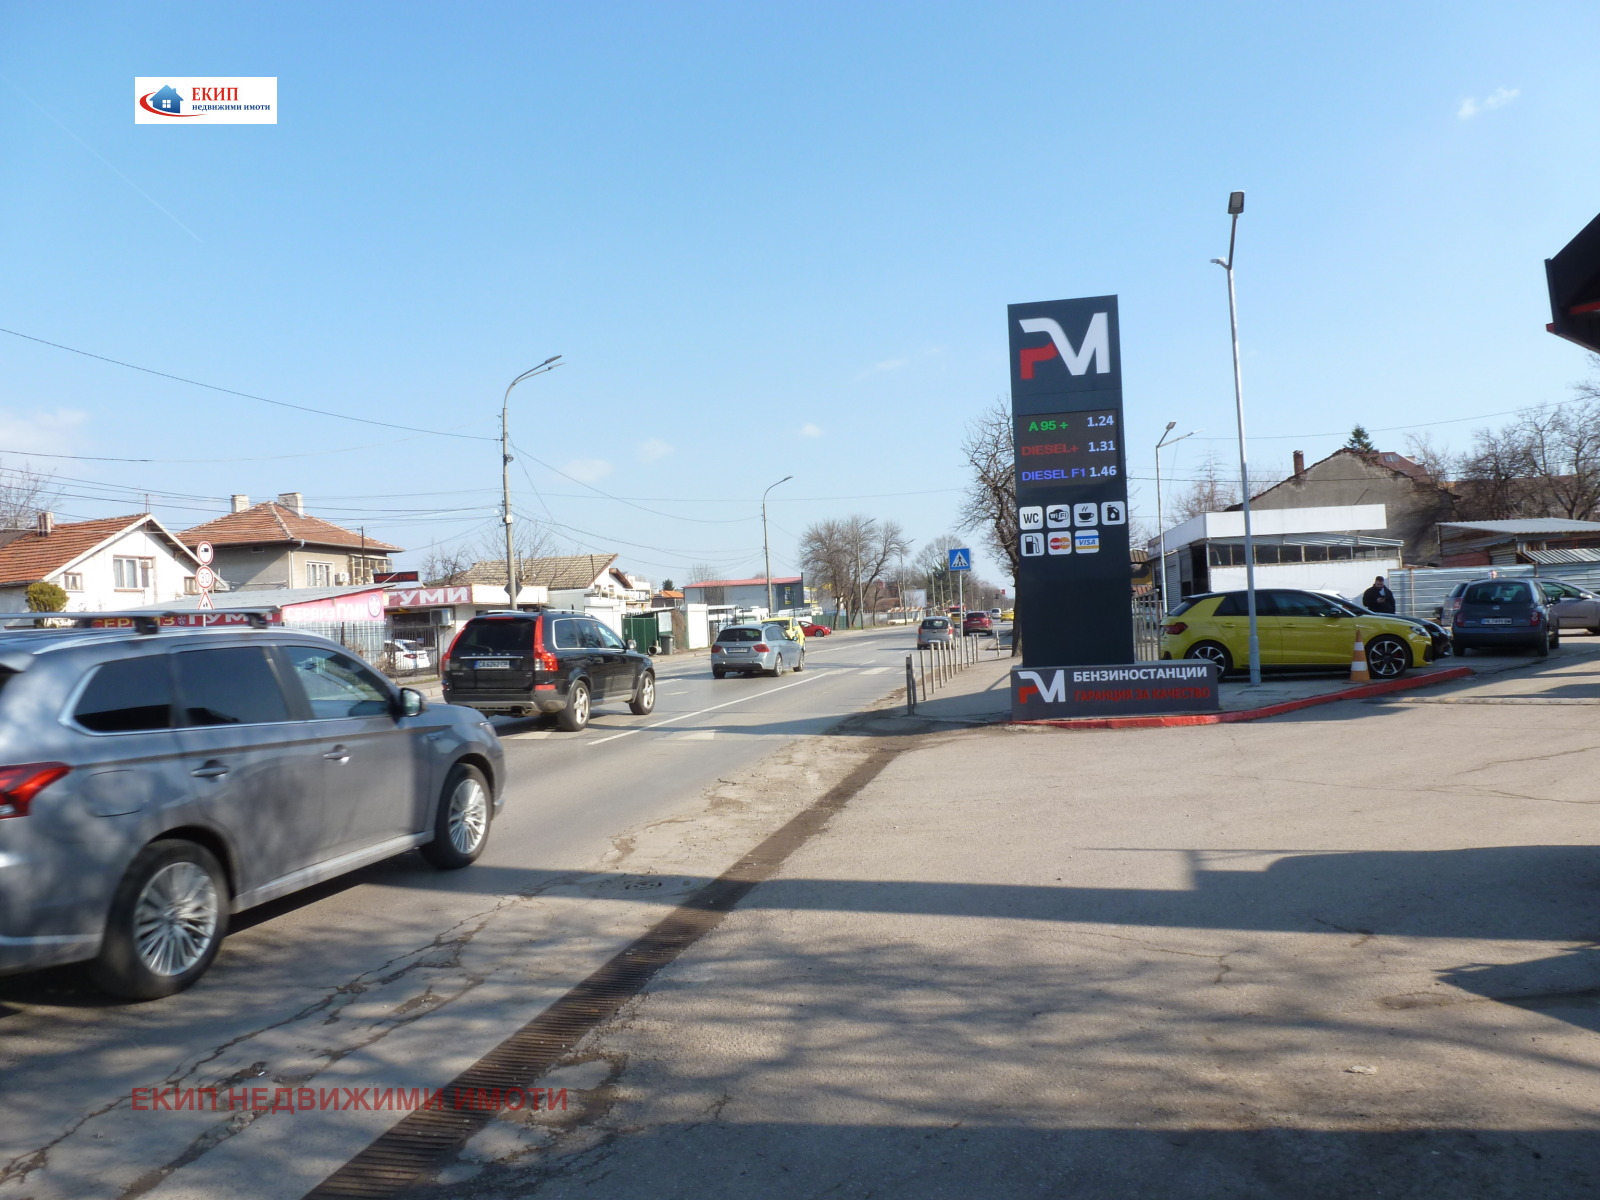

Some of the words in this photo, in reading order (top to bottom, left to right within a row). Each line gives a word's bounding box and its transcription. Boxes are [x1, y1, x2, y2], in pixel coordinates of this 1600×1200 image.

[1028, 421, 1038, 431] A
[1040, 420, 1057, 431] 95
[1087, 415, 1114, 427] 1.24
[1021, 443, 1079, 456] DIESEL+
[1088, 440, 1116, 452] 1.31
[1022, 469, 1069, 481] DIESEL
[1071, 468, 1086, 478] F1
[1089, 465, 1117, 477] 1.46
[1023, 513, 1039, 524] WC
[388, 587, 468, 605] ГУМИ
[285, 607, 335, 620] СЕРВИЗ
[336, 603, 369, 619] ГУМИ
[1073, 667, 1208, 683] БЕНЗИНОСТАНЦИИ
[1074, 688, 1134, 702] ГАРАНЦИЯ
[1136, 687, 1149, 700] ЗА
[1152, 686, 1211, 699] КАЧЕСТВО
